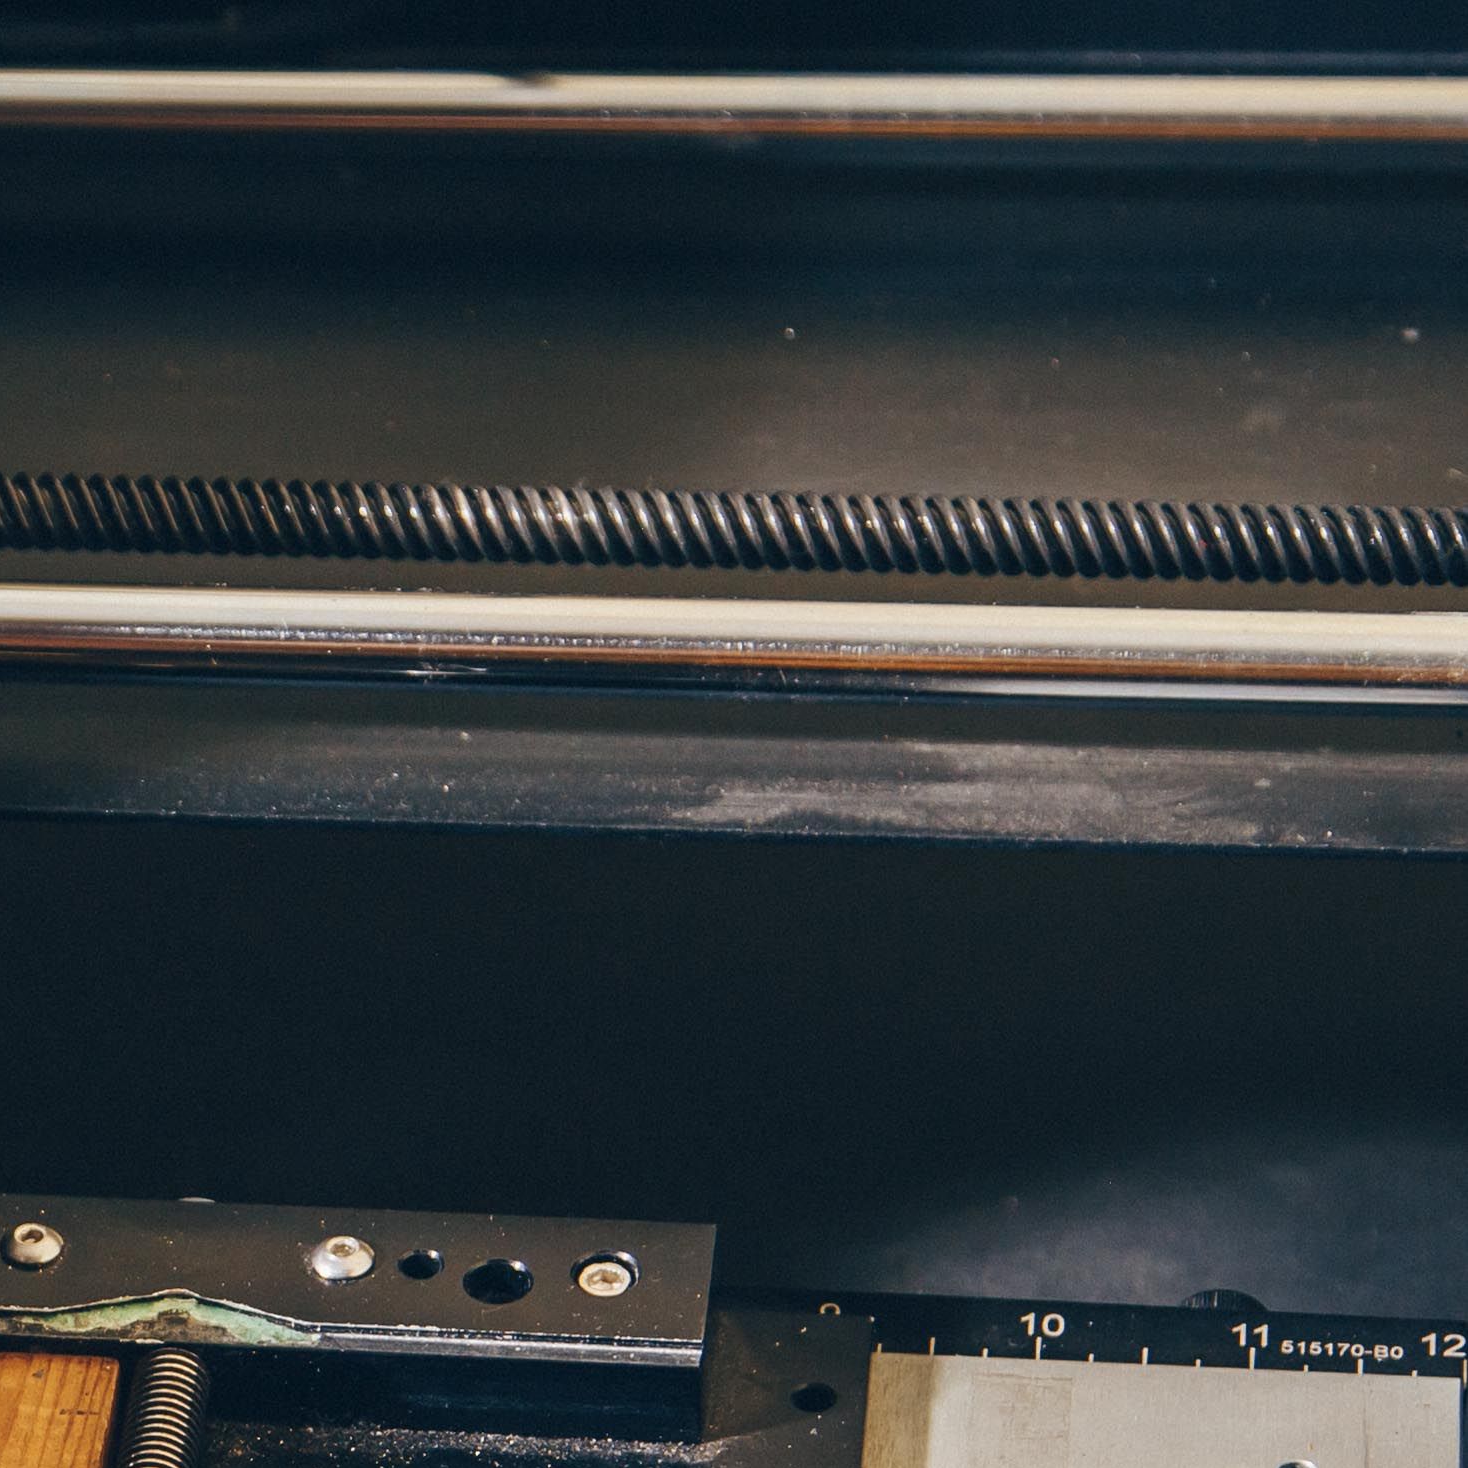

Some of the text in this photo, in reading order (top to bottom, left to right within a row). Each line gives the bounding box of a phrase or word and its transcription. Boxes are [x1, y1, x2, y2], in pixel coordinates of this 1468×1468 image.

[1020, 1311, 1065, 1337] 10
[1231, 1322, 1269, 1348] 11
[1280, 1339, 1404, 1359] 515170-B0
[1420, 1331, 1467, 1358] 12
